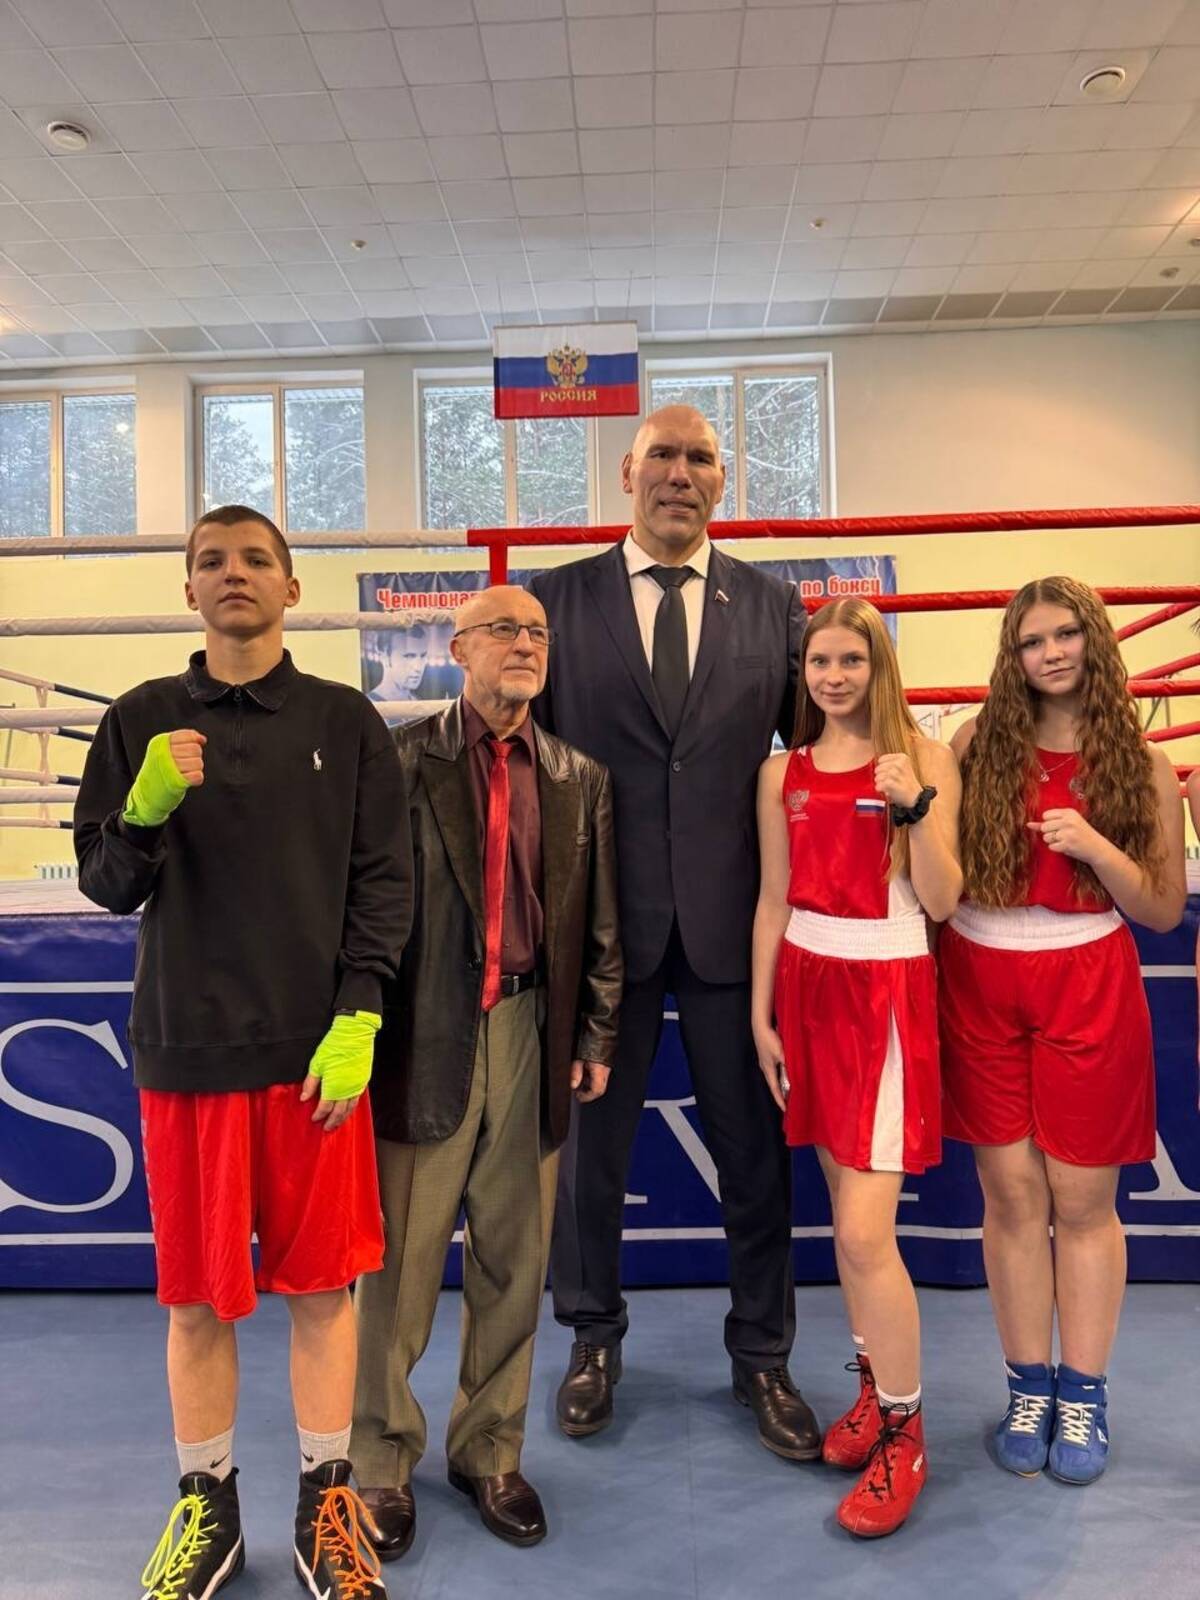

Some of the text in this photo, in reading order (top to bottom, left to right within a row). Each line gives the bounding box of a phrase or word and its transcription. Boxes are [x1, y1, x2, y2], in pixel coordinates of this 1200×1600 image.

[540, 389, 598, 403] РОССИЯ
[801, 580, 824, 596] по
[827, 575, 882, 597] боксу
